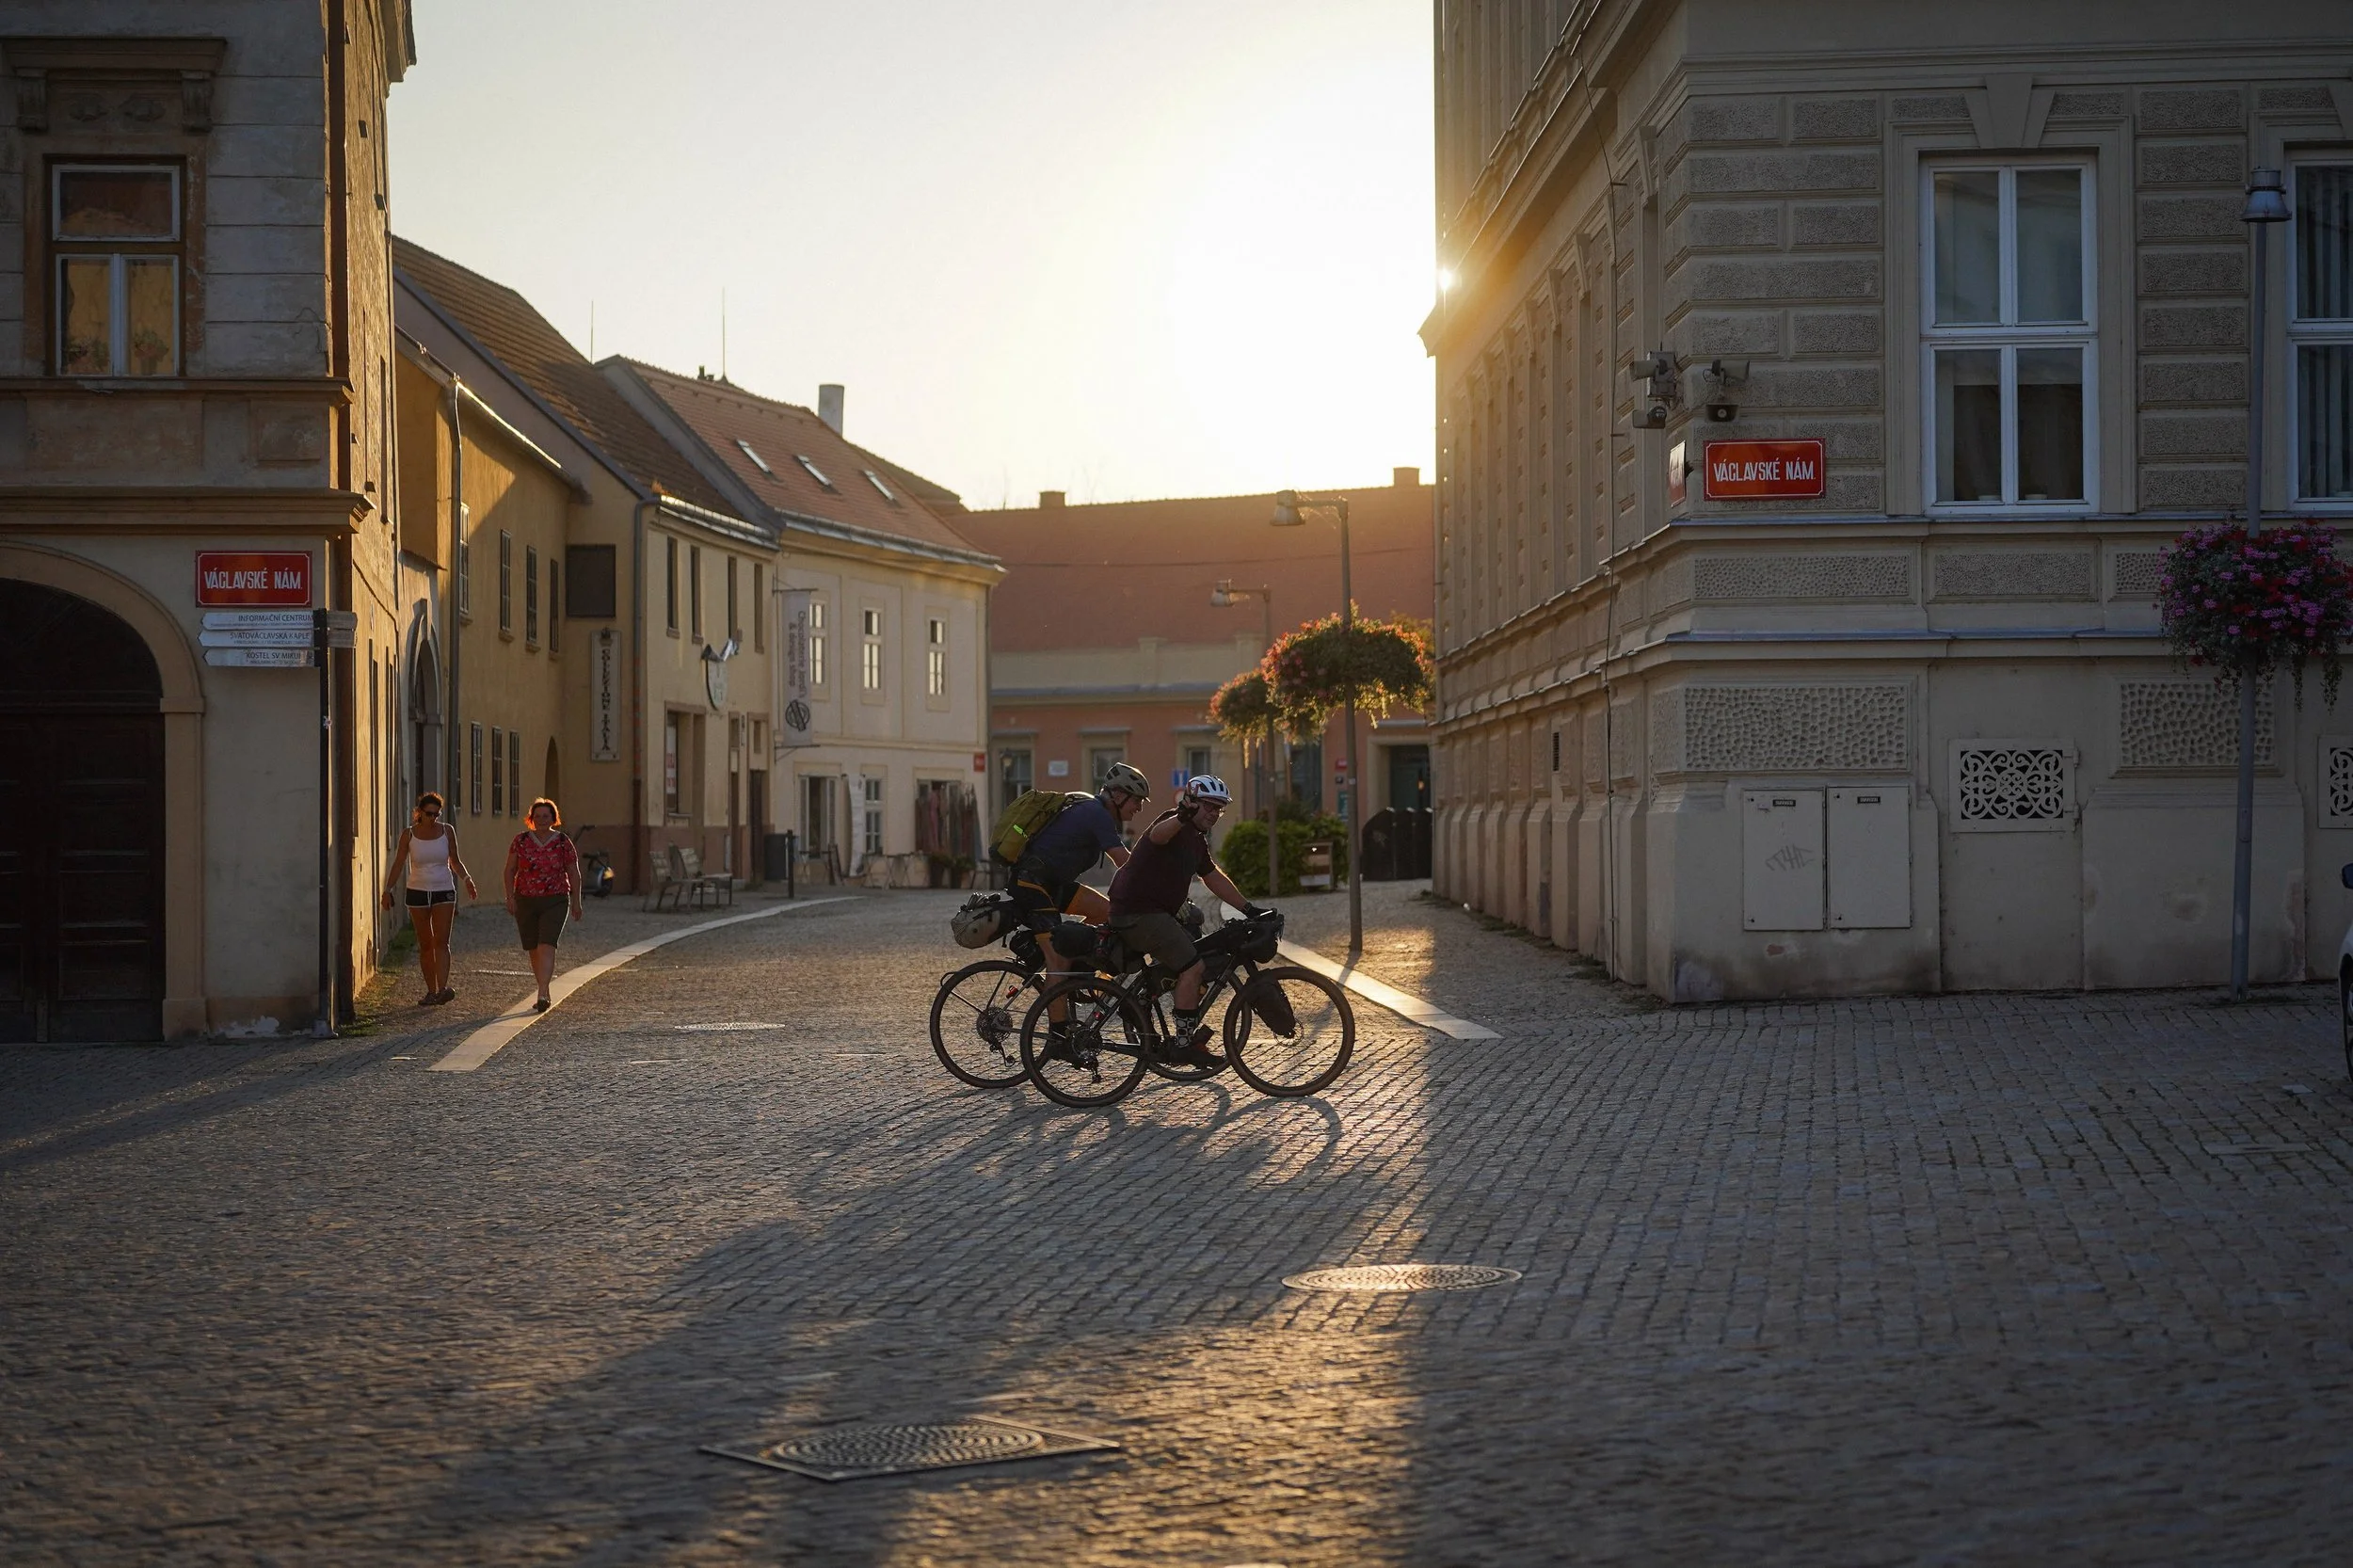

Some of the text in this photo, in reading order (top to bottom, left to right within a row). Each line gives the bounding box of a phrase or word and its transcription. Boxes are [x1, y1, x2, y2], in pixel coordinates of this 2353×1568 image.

[1713, 457, 1781, 482] VÁCLAVSKÉ
[1785, 456, 1817, 481] NÁM.
[204, 568, 303, 589] VÁCLAVSKÉ NÁM.
[238, 614, 281, 622] INFORMAČNÍ
[230, 632, 288, 640] SVATOVÁCLAVSKÁ
[246, 651, 269, 660] KOSTEL
